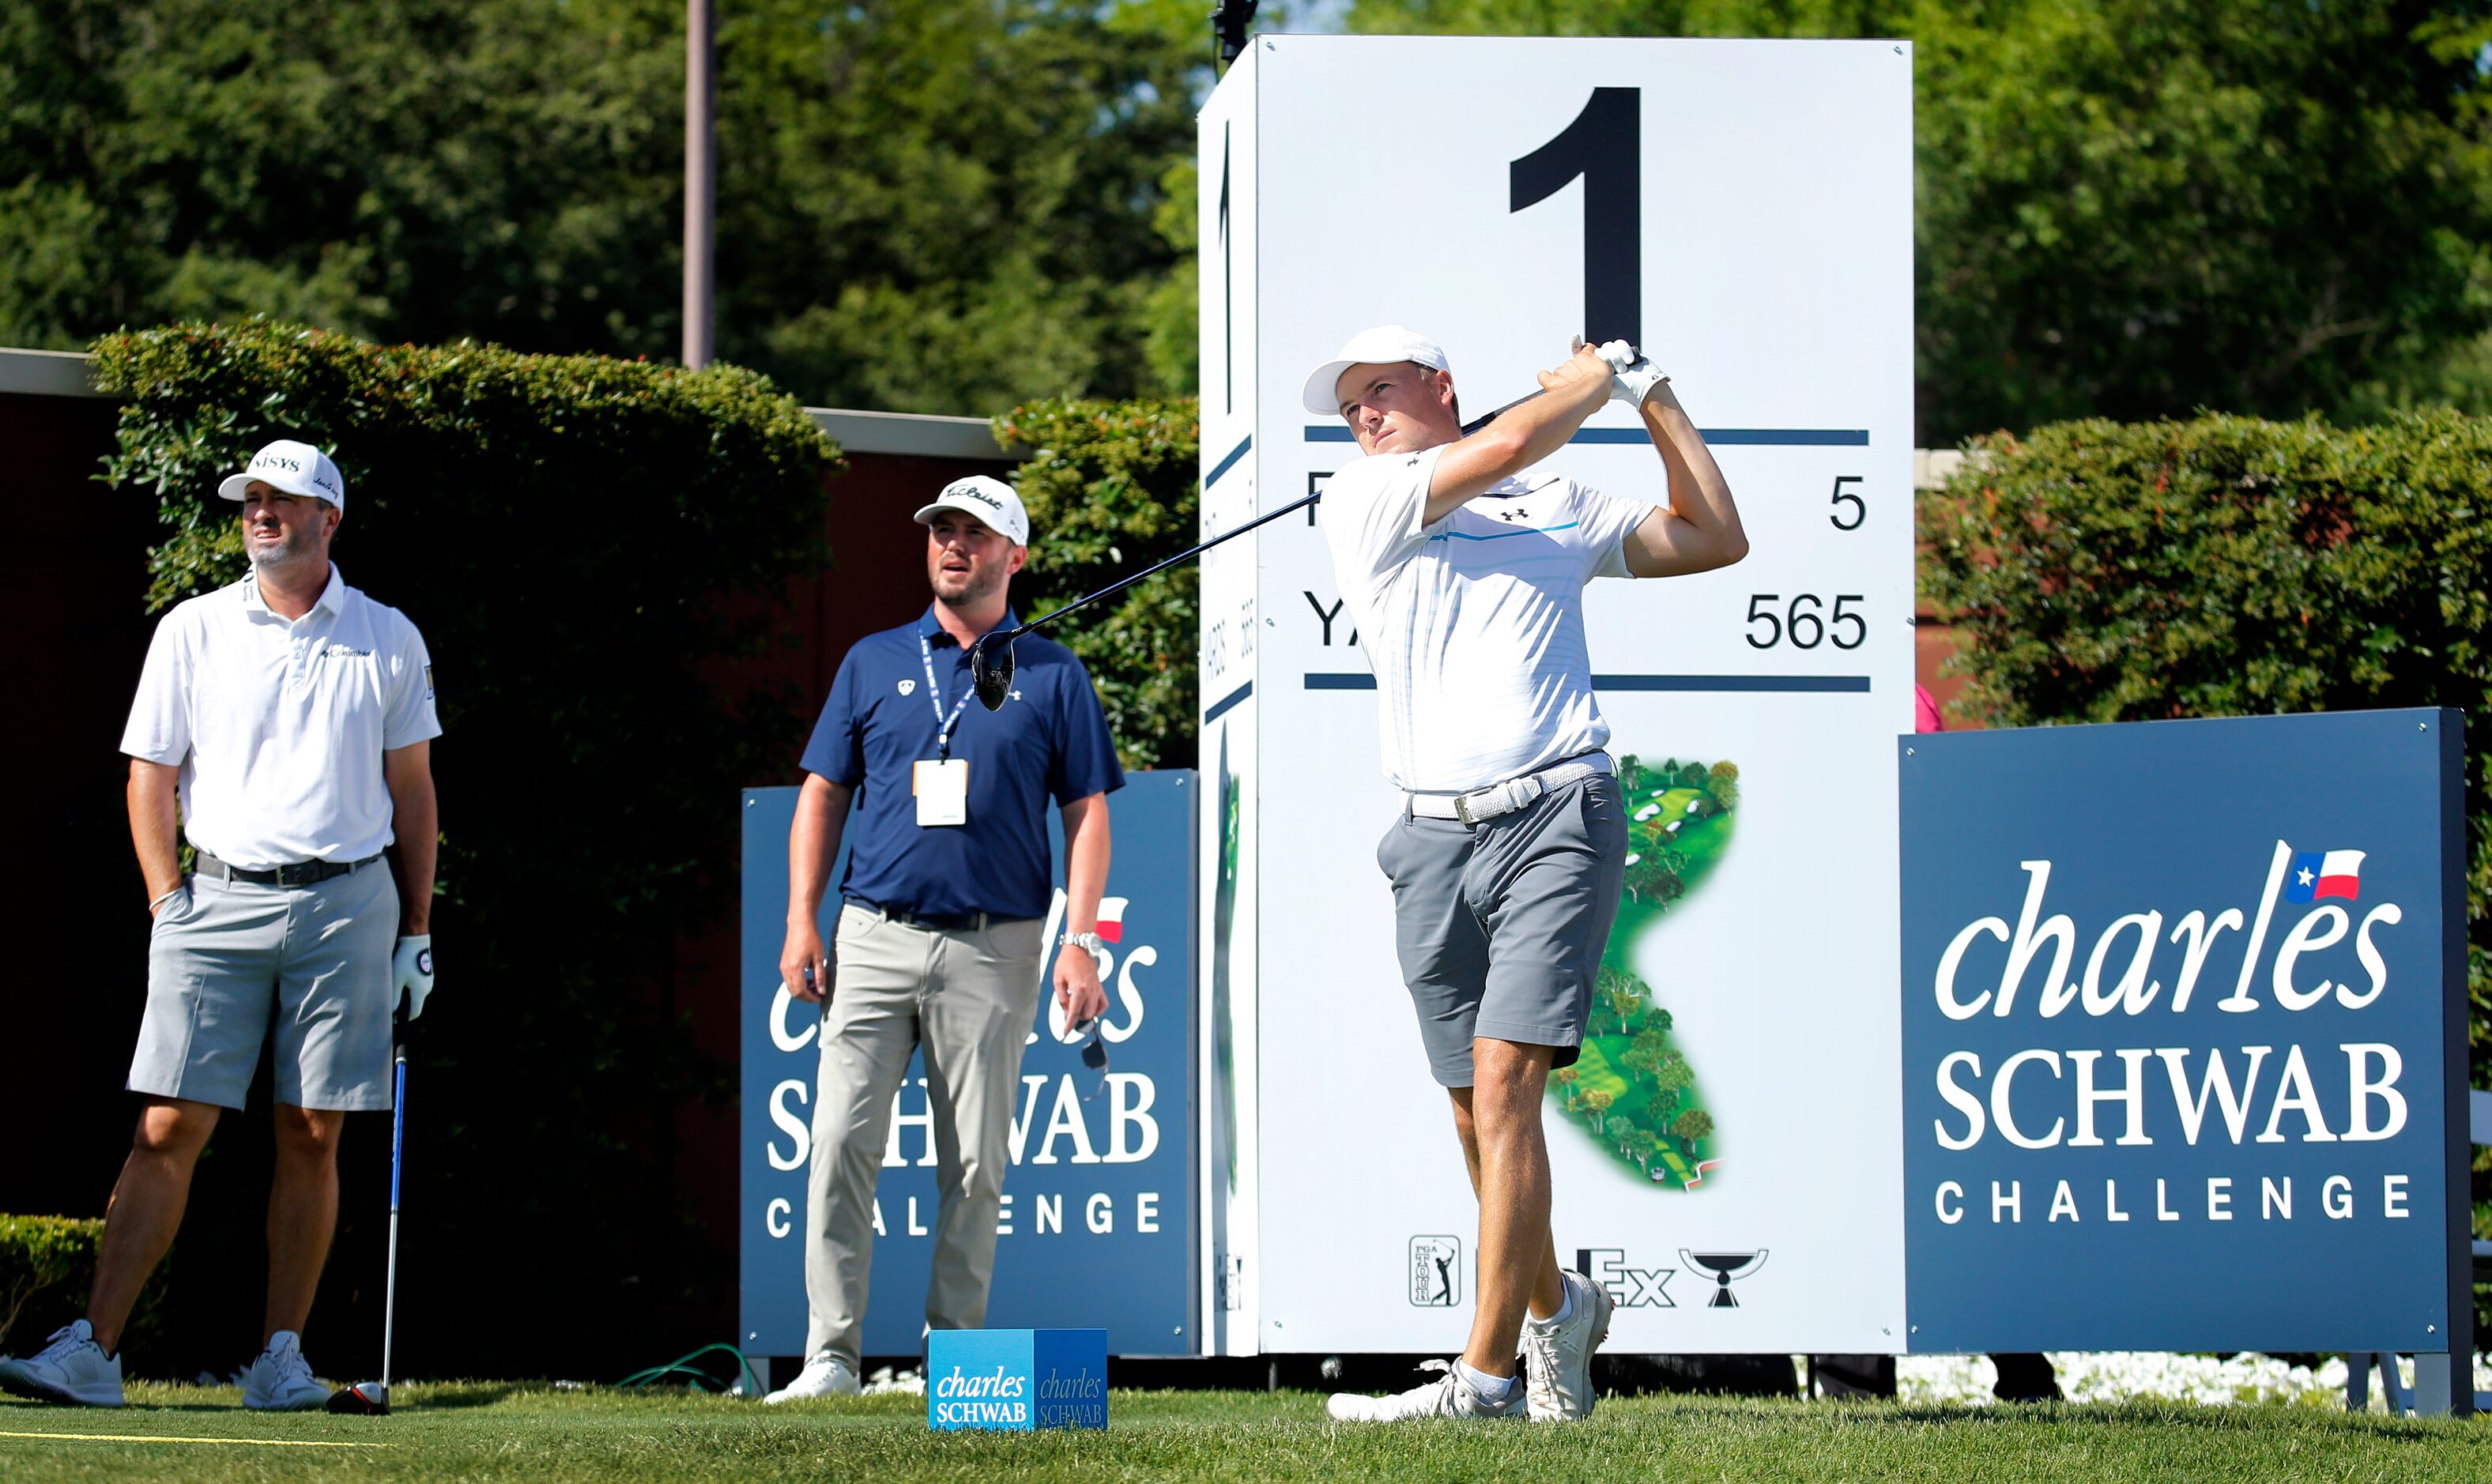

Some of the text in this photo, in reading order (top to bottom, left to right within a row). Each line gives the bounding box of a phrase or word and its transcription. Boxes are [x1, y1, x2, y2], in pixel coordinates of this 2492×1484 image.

[1510, 87, 1641, 355] 1
[1219, 119, 1231, 415] 1
[1830, 476, 1866, 530] 5
[1745, 593, 1867, 650] 565
[1934, 838, 2403, 1020] charles
[1934, 1042, 2408, 1151] SCHWAB
[1935, 1173, 2409, 1225] CHALLENGE
[1416, 1254, 1430, 1301] TOUR
[937, 1365, 1025, 1398] charles
[1040, 1368, 1101, 1399] charles
[937, 1402, 1027, 1423] SCHWAB
[1040, 1404, 1102, 1424] SCHWAB
